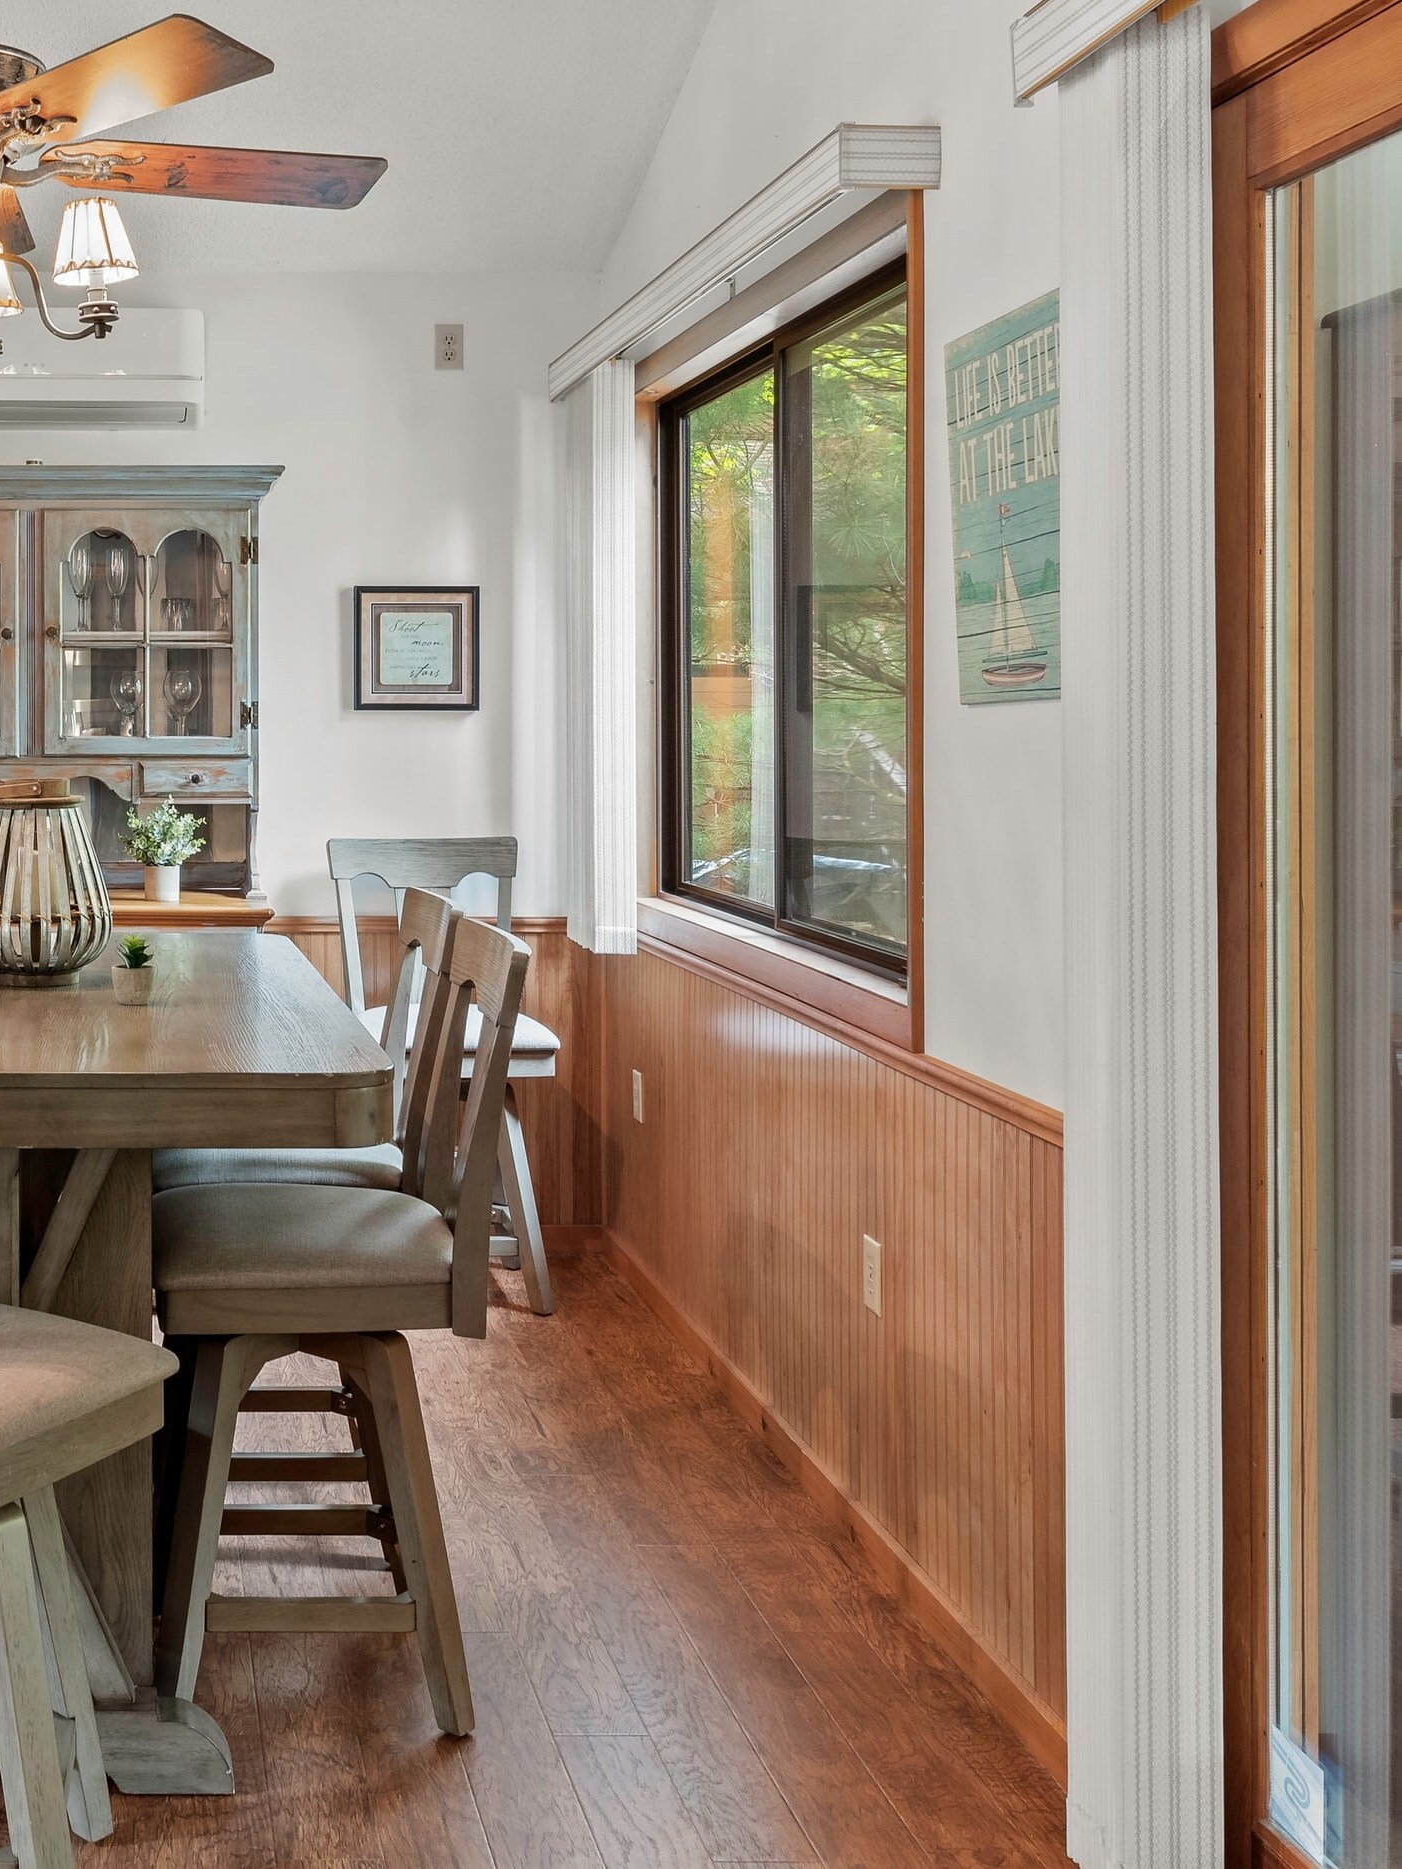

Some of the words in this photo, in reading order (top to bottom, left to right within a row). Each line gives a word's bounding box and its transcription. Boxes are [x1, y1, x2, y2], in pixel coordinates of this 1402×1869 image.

[954, 360, 982, 429] LIFE
[987, 352, 1001, 417] IS
[959, 438, 977, 504] AT
[983, 422, 1017, 496] THE
[1022, 404, 1060, 484] LAK
